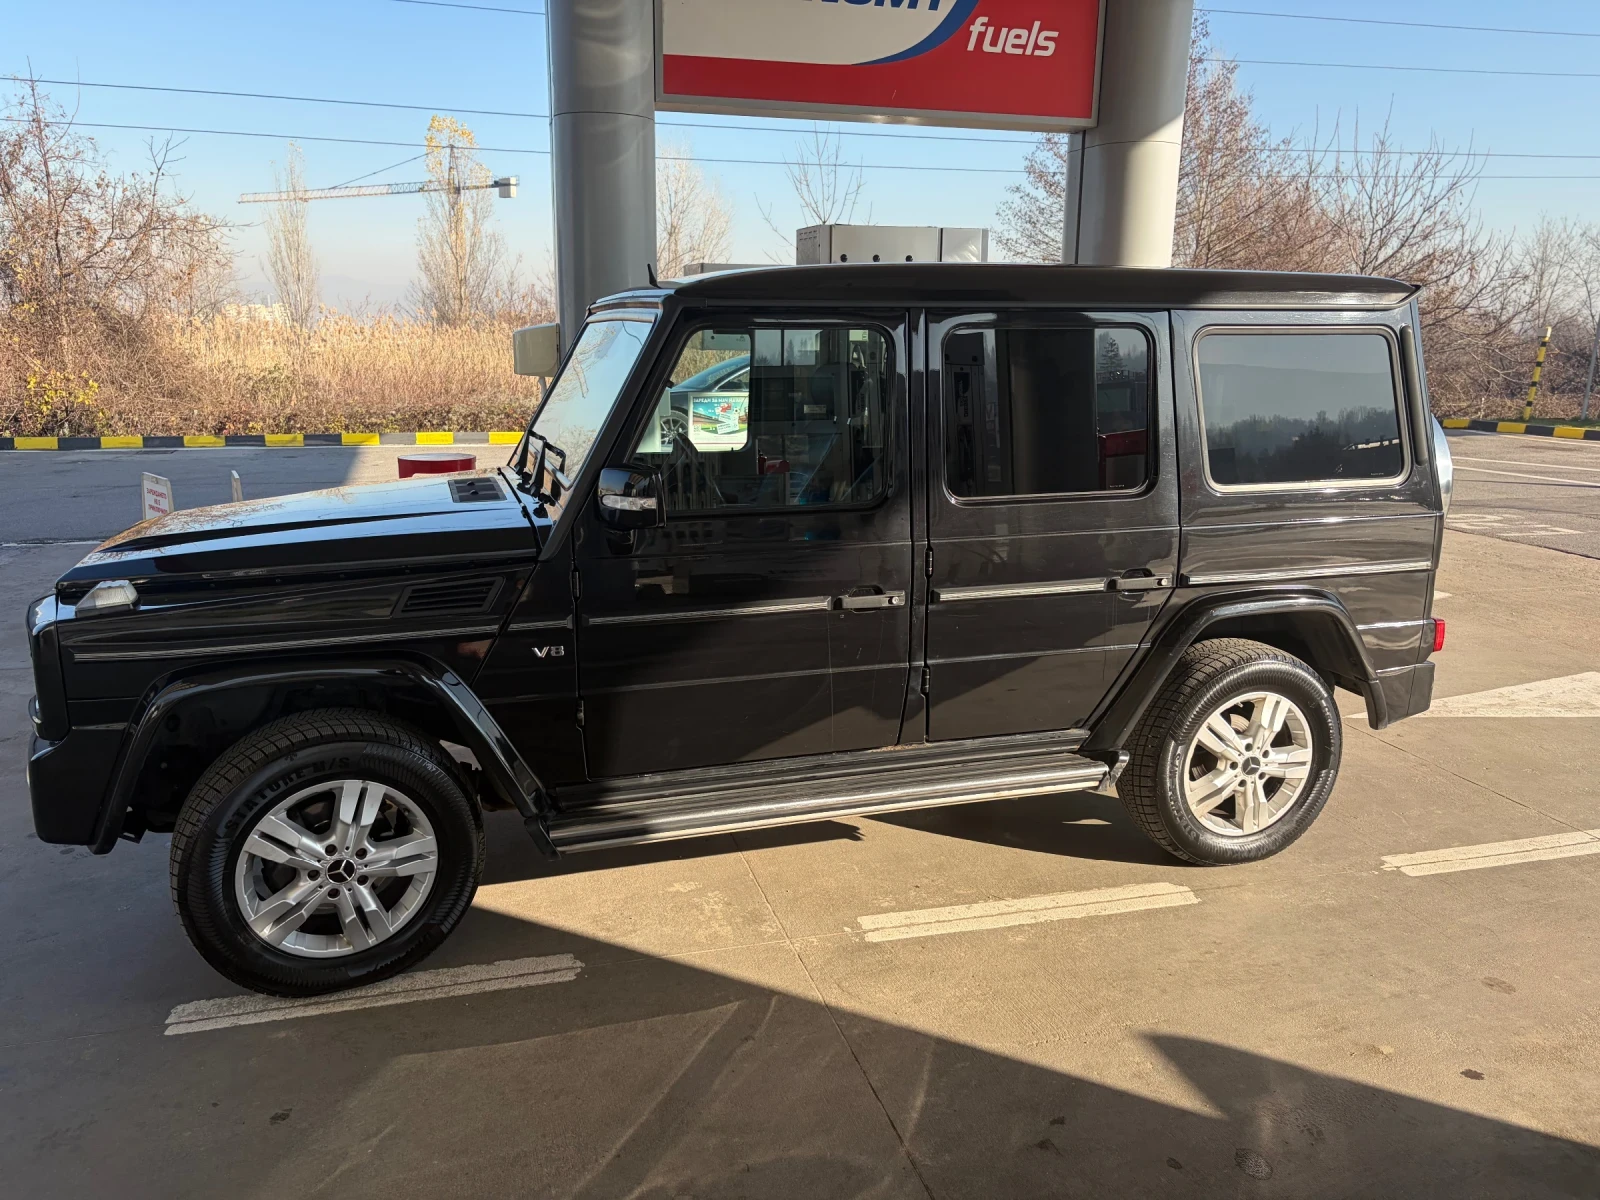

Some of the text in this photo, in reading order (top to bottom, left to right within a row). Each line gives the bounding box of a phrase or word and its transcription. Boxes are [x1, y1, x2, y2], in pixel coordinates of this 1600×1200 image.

[965, 15, 1059, 57] fuels
[531, 645, 565, 658] V8
[224, 766, 309, 831] STATURE
